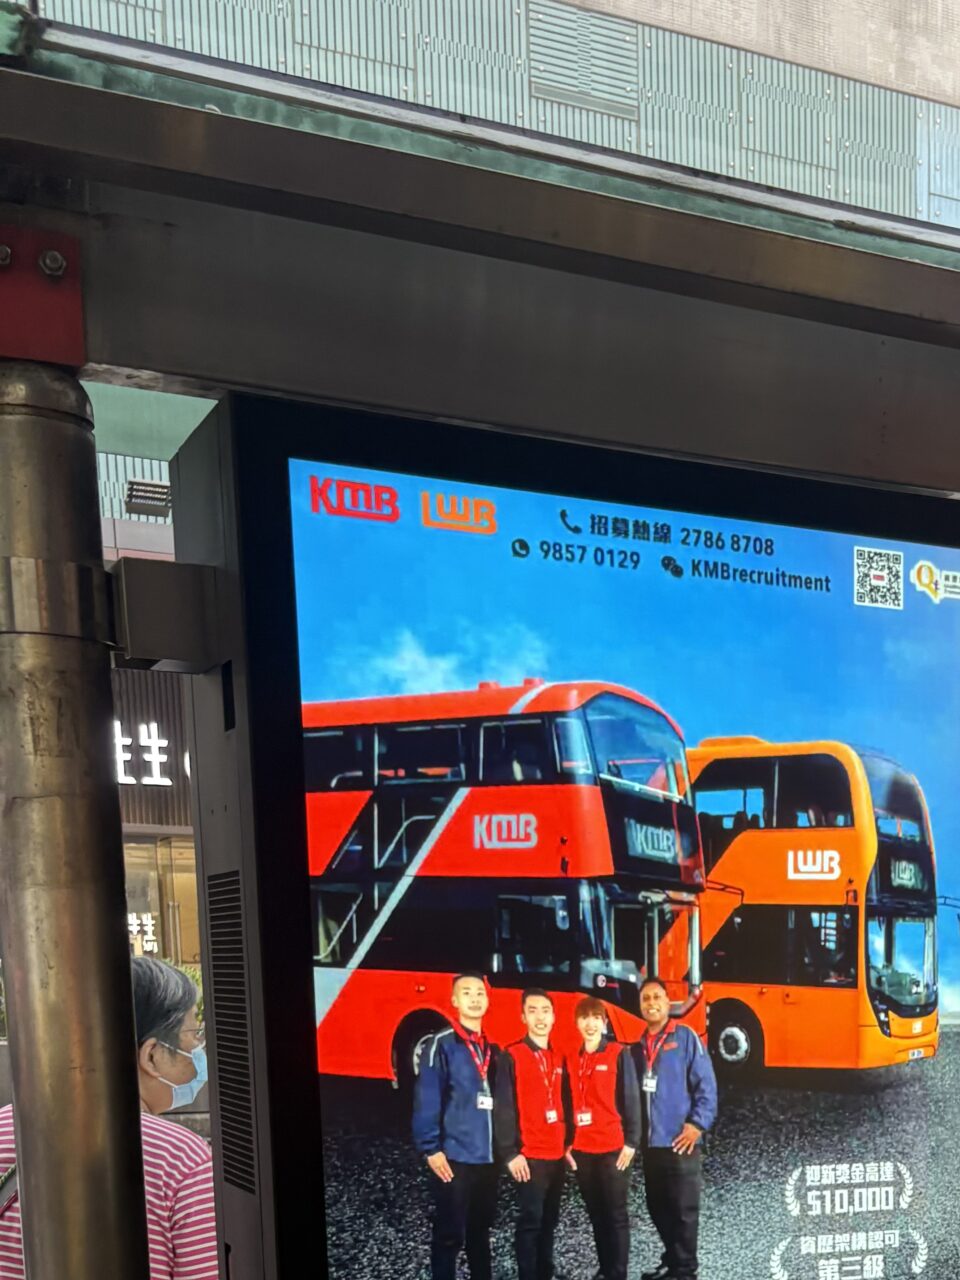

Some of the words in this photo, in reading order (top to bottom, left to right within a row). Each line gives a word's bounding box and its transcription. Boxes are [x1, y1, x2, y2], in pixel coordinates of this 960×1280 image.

[309, 475, 400, 523] KMB
[420, 491, 498, 535] LWB
[589, 512, 673, 545] 招募熱線
[679, 527, 726, 551] 2786
[730, 534, 775, 557] 8708
[538, 540, 588, 565] 9857
[593, 545, 641, 570] 0129
[690, 558, 832, 593] KMBrecruitment
[473, 813, 538, 850] KMB
[787, 850, 841, 881] LWB
[805, 1161, 896, 1187] 迎新獎金高達
[806, 1185, 895, 1216] $10,000
